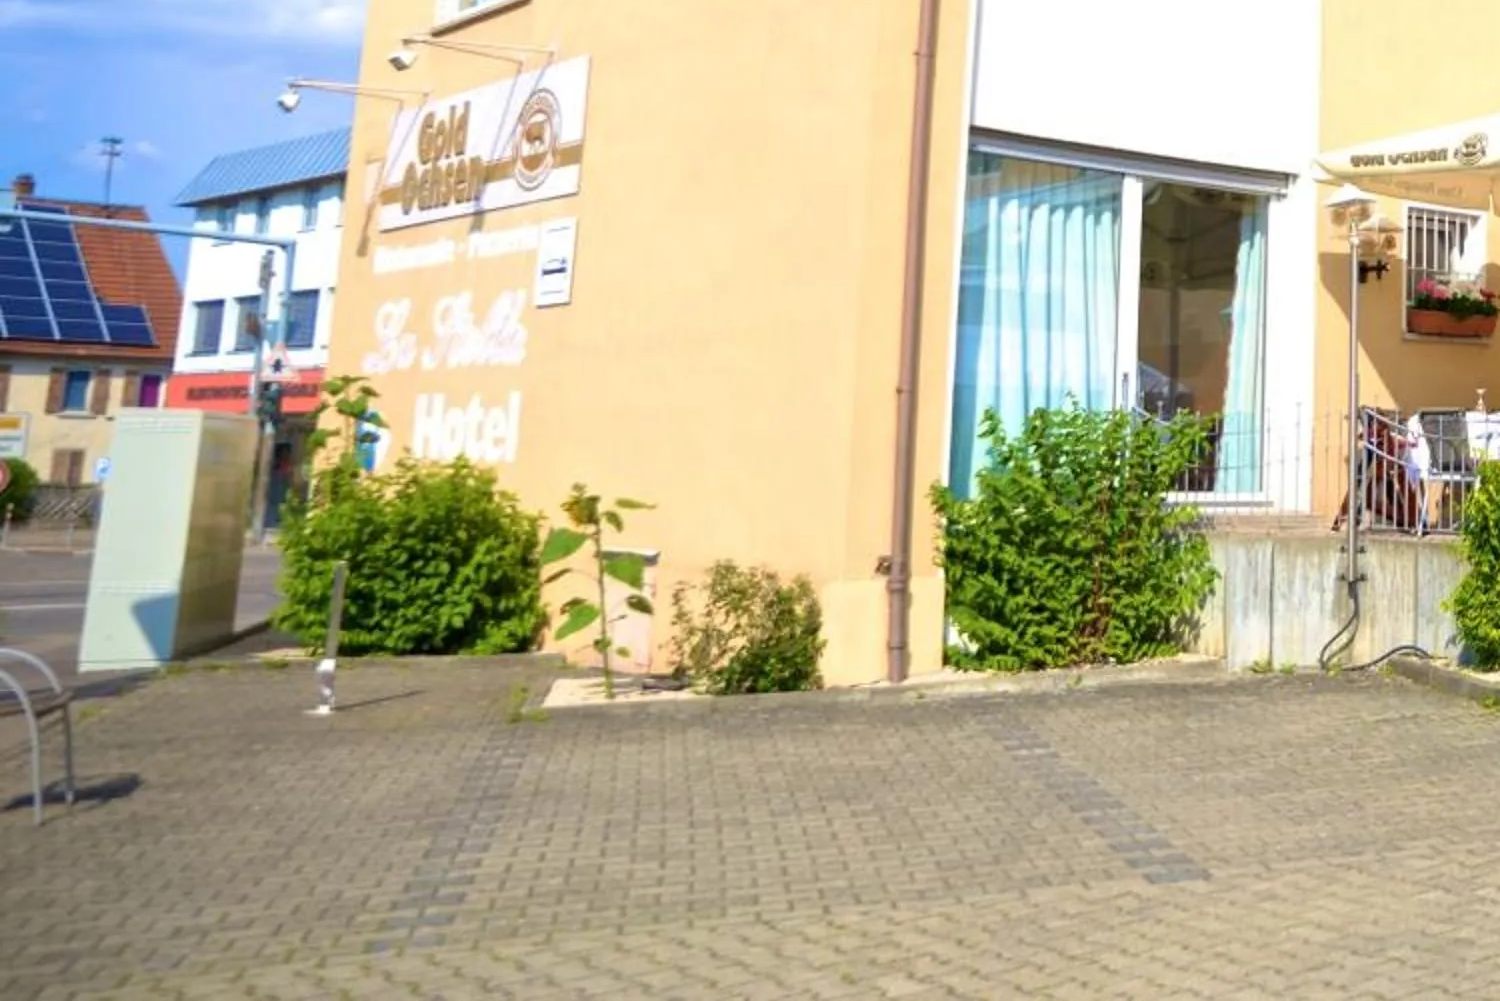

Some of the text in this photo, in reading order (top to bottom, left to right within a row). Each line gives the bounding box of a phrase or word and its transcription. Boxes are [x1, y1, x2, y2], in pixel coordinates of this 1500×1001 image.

[418, 100, 471, 166] Gold
[401, 154, 484, 216] Ochsen
[412, 389, 522, 464] Hotel
